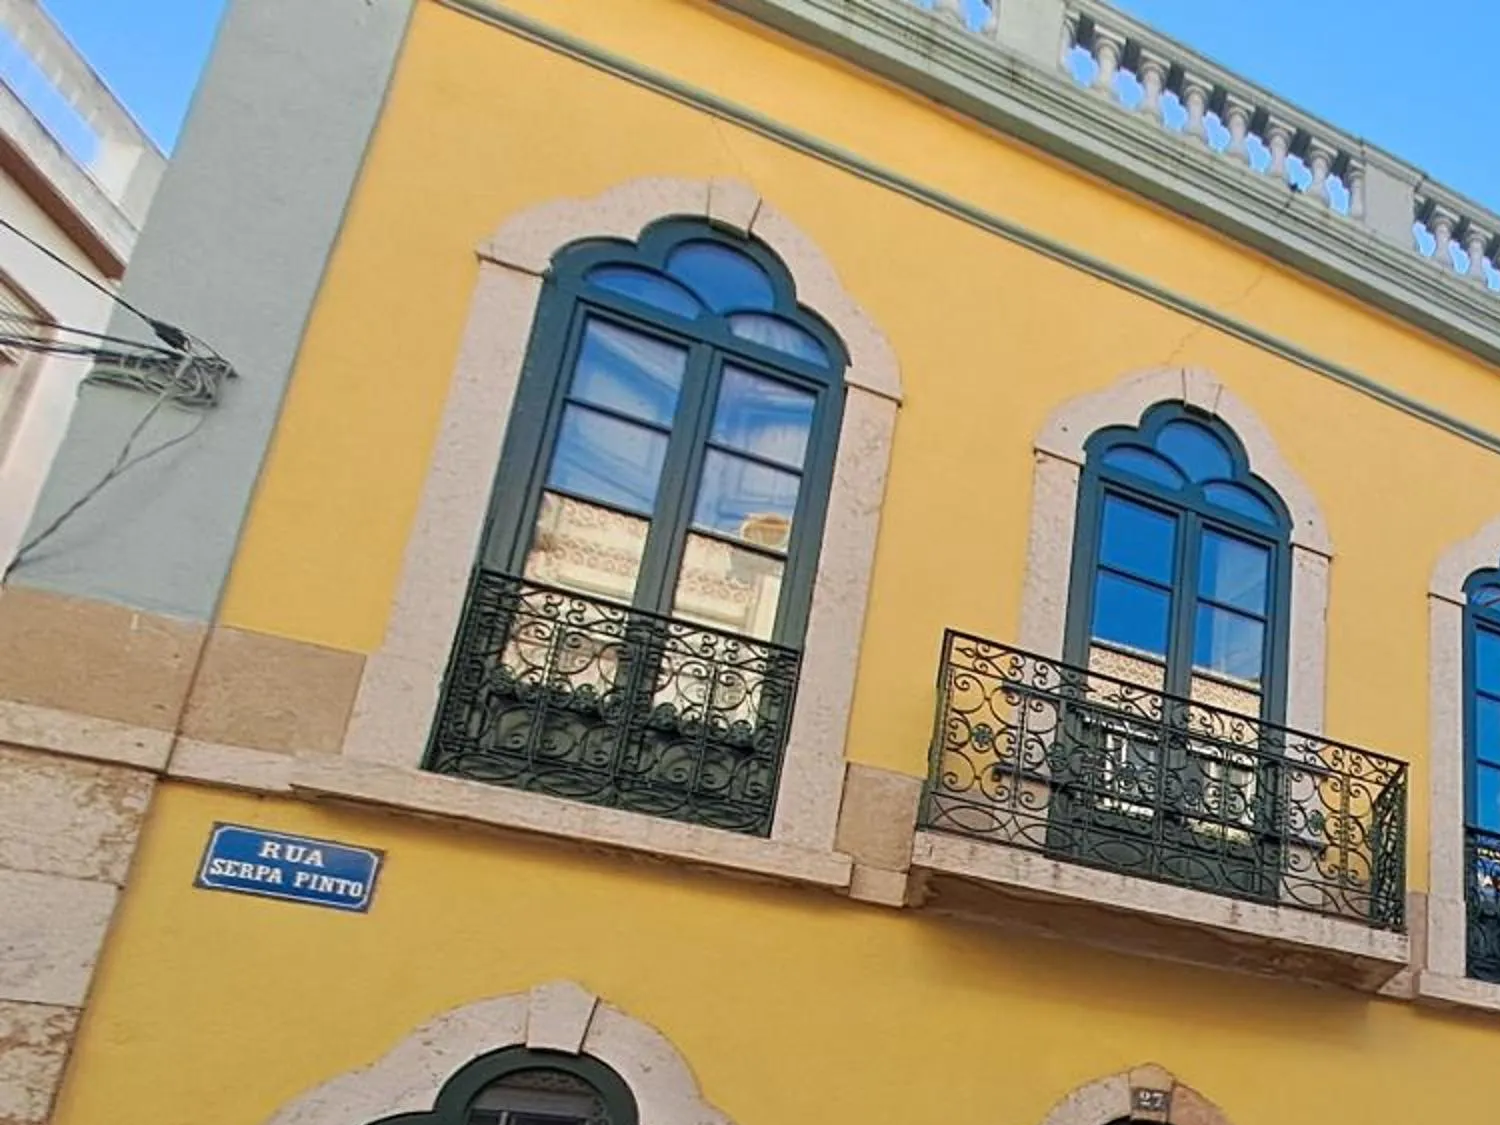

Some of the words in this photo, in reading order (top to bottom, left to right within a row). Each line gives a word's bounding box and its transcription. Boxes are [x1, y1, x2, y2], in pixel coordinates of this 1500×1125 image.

[258, 841, 324, 867] RUA
[209, 858, 283, 884] SERPA
[293, 871, 363, 897] PINTO
